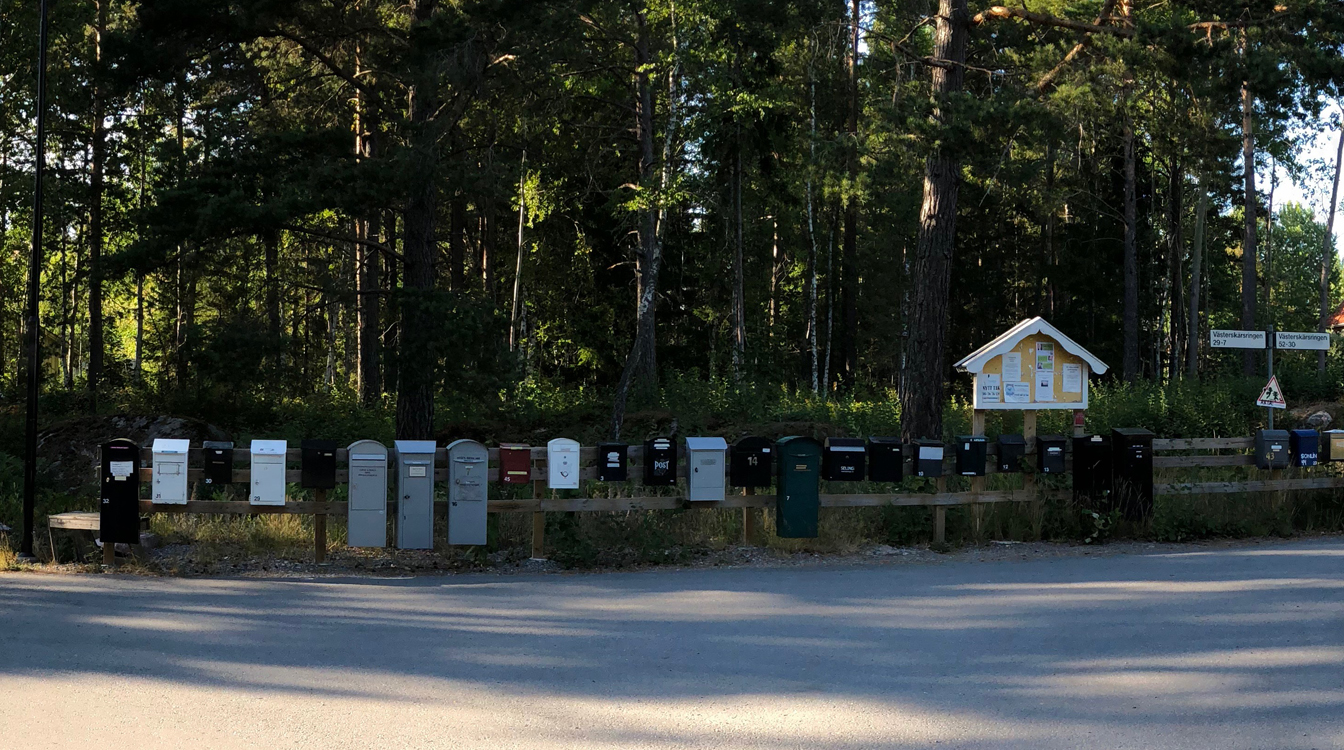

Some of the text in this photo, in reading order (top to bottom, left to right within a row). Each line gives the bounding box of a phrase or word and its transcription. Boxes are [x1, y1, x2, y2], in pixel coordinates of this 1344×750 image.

[1212, 331, 1263, 340] Västerskärsringen
[1278, 333, 1328, 341] Västerskärsringen
[654, 460, 670, 470] POST
[747, 456, 758, 466] 14
